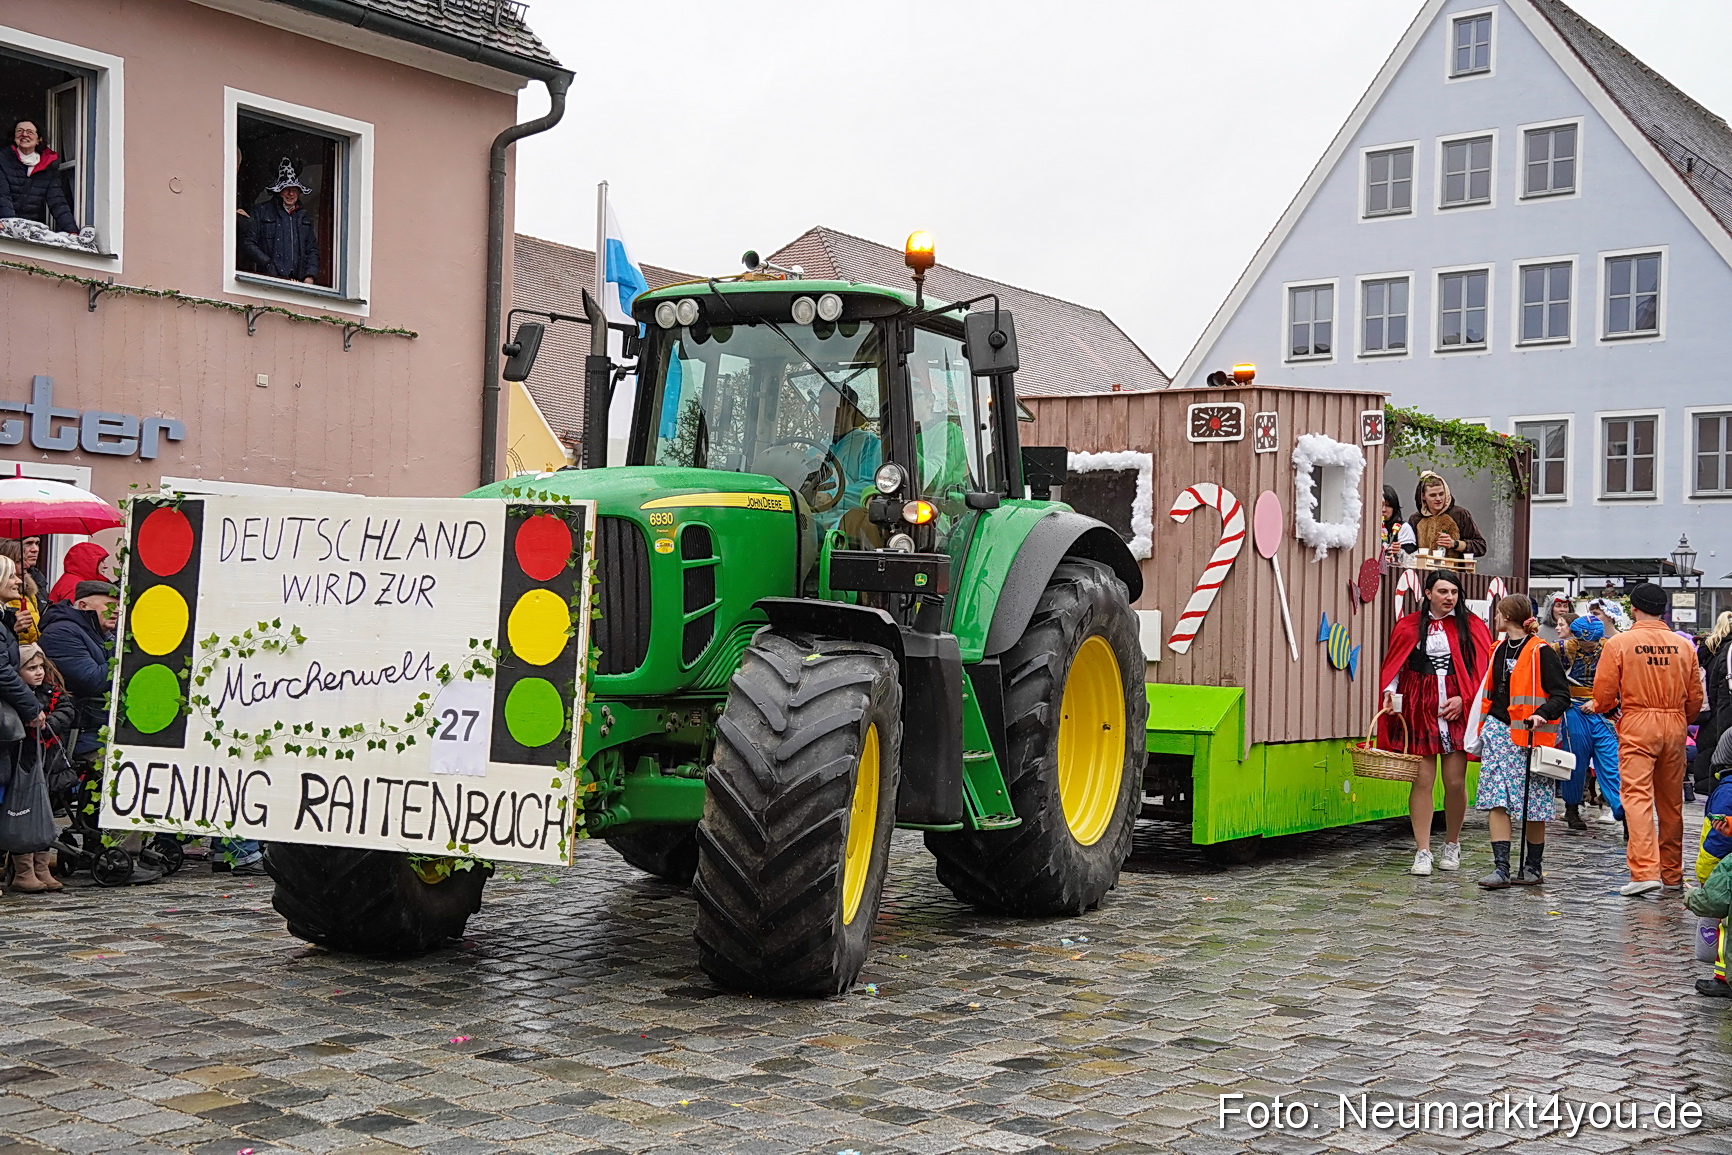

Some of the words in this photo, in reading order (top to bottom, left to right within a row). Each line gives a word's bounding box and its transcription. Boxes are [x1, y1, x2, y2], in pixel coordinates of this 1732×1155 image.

[649, 511, 674, 527] 6930
[746, 495, 763, 507] JOHN
[762, 496, 783, 509] DEERE
[220, 517, 486, 562] DEUTSCHLAND
[282, 571, 366, 605] WIRD
[374, 573, 436, 608] ZUR
[1634, 645, 1679, 655] COUNTY
[1647, 656, 1670, 666] JAIL
[215, 650, 435, 712] Märchenwelt
[439, 708, 480, 742] 27
[111, 761, 271, 827] OENING
[294, 771, 568, 851] RAITENBUCH
